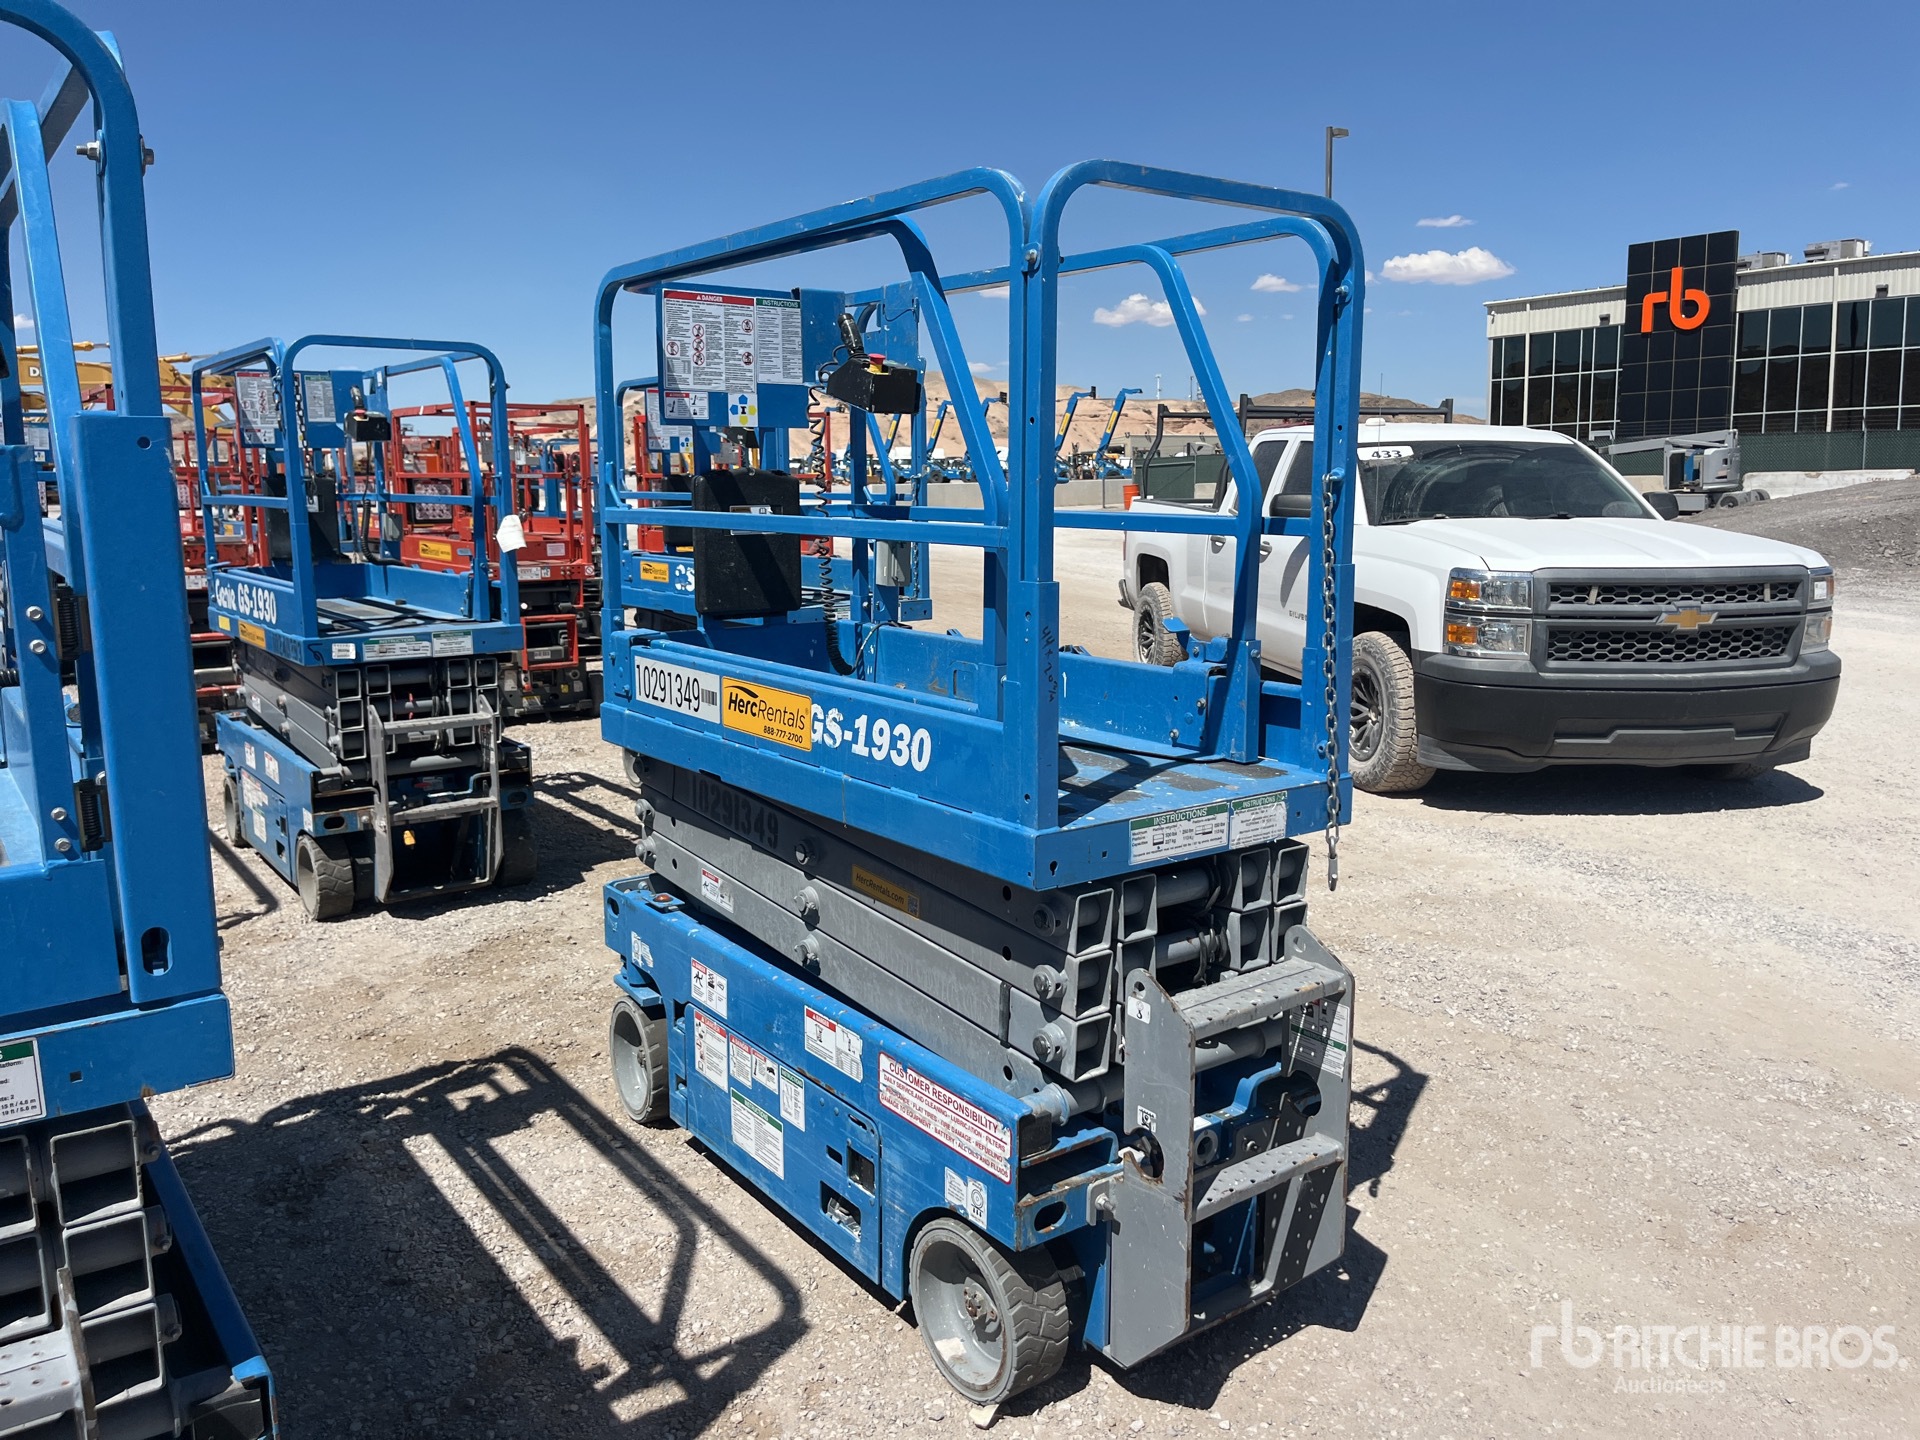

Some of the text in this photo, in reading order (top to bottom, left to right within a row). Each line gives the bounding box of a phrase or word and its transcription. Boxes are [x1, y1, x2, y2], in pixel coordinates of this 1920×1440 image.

[702, 294, 723, 302] DANGER
[762, 300, 798, 308] INSTRUCTIONS
[1641, 267, 1710, 333] rb
[1372, 450, 1402, 458] 433
[238, 583, 276, 624] GS-1930
[636, 664, 700, 712] 10291349
[728, 692, 806, 730] HercRentals
[764, 726, 803, 744] 888-777-2700
[811, 704, 932, 772] GS-1930
[692, 775, 779, 849] 10291349
[1153, 808, 1207, 826] INSTRUCTIONS
[856, 873, 904, 904] HercRentals.com
[884, 1074, 1005, 1152] DAILY SERVICE AND CLEANING LUBRICATION FILTERS
[890, 1062, 998, 1134] CUSTOMER RESPONSIBILITY
[880, 1094, 899, 1110] DAMAGE
[900, 1105, 906, 1114] TO
[906, 1108, 932, 1130] EQUIPMENT
[934, 1127, 955, 1144] BATTERY
[990, 1161, 1008, 1178] FLUIDS
[913, 1102, 924, 1113] FLAT
[924, 1108, 937, 1122] TIRES
[951, 1126, 971, 1144] DAMAGE
[975, 1140, 1003, 1162] REFUELING
